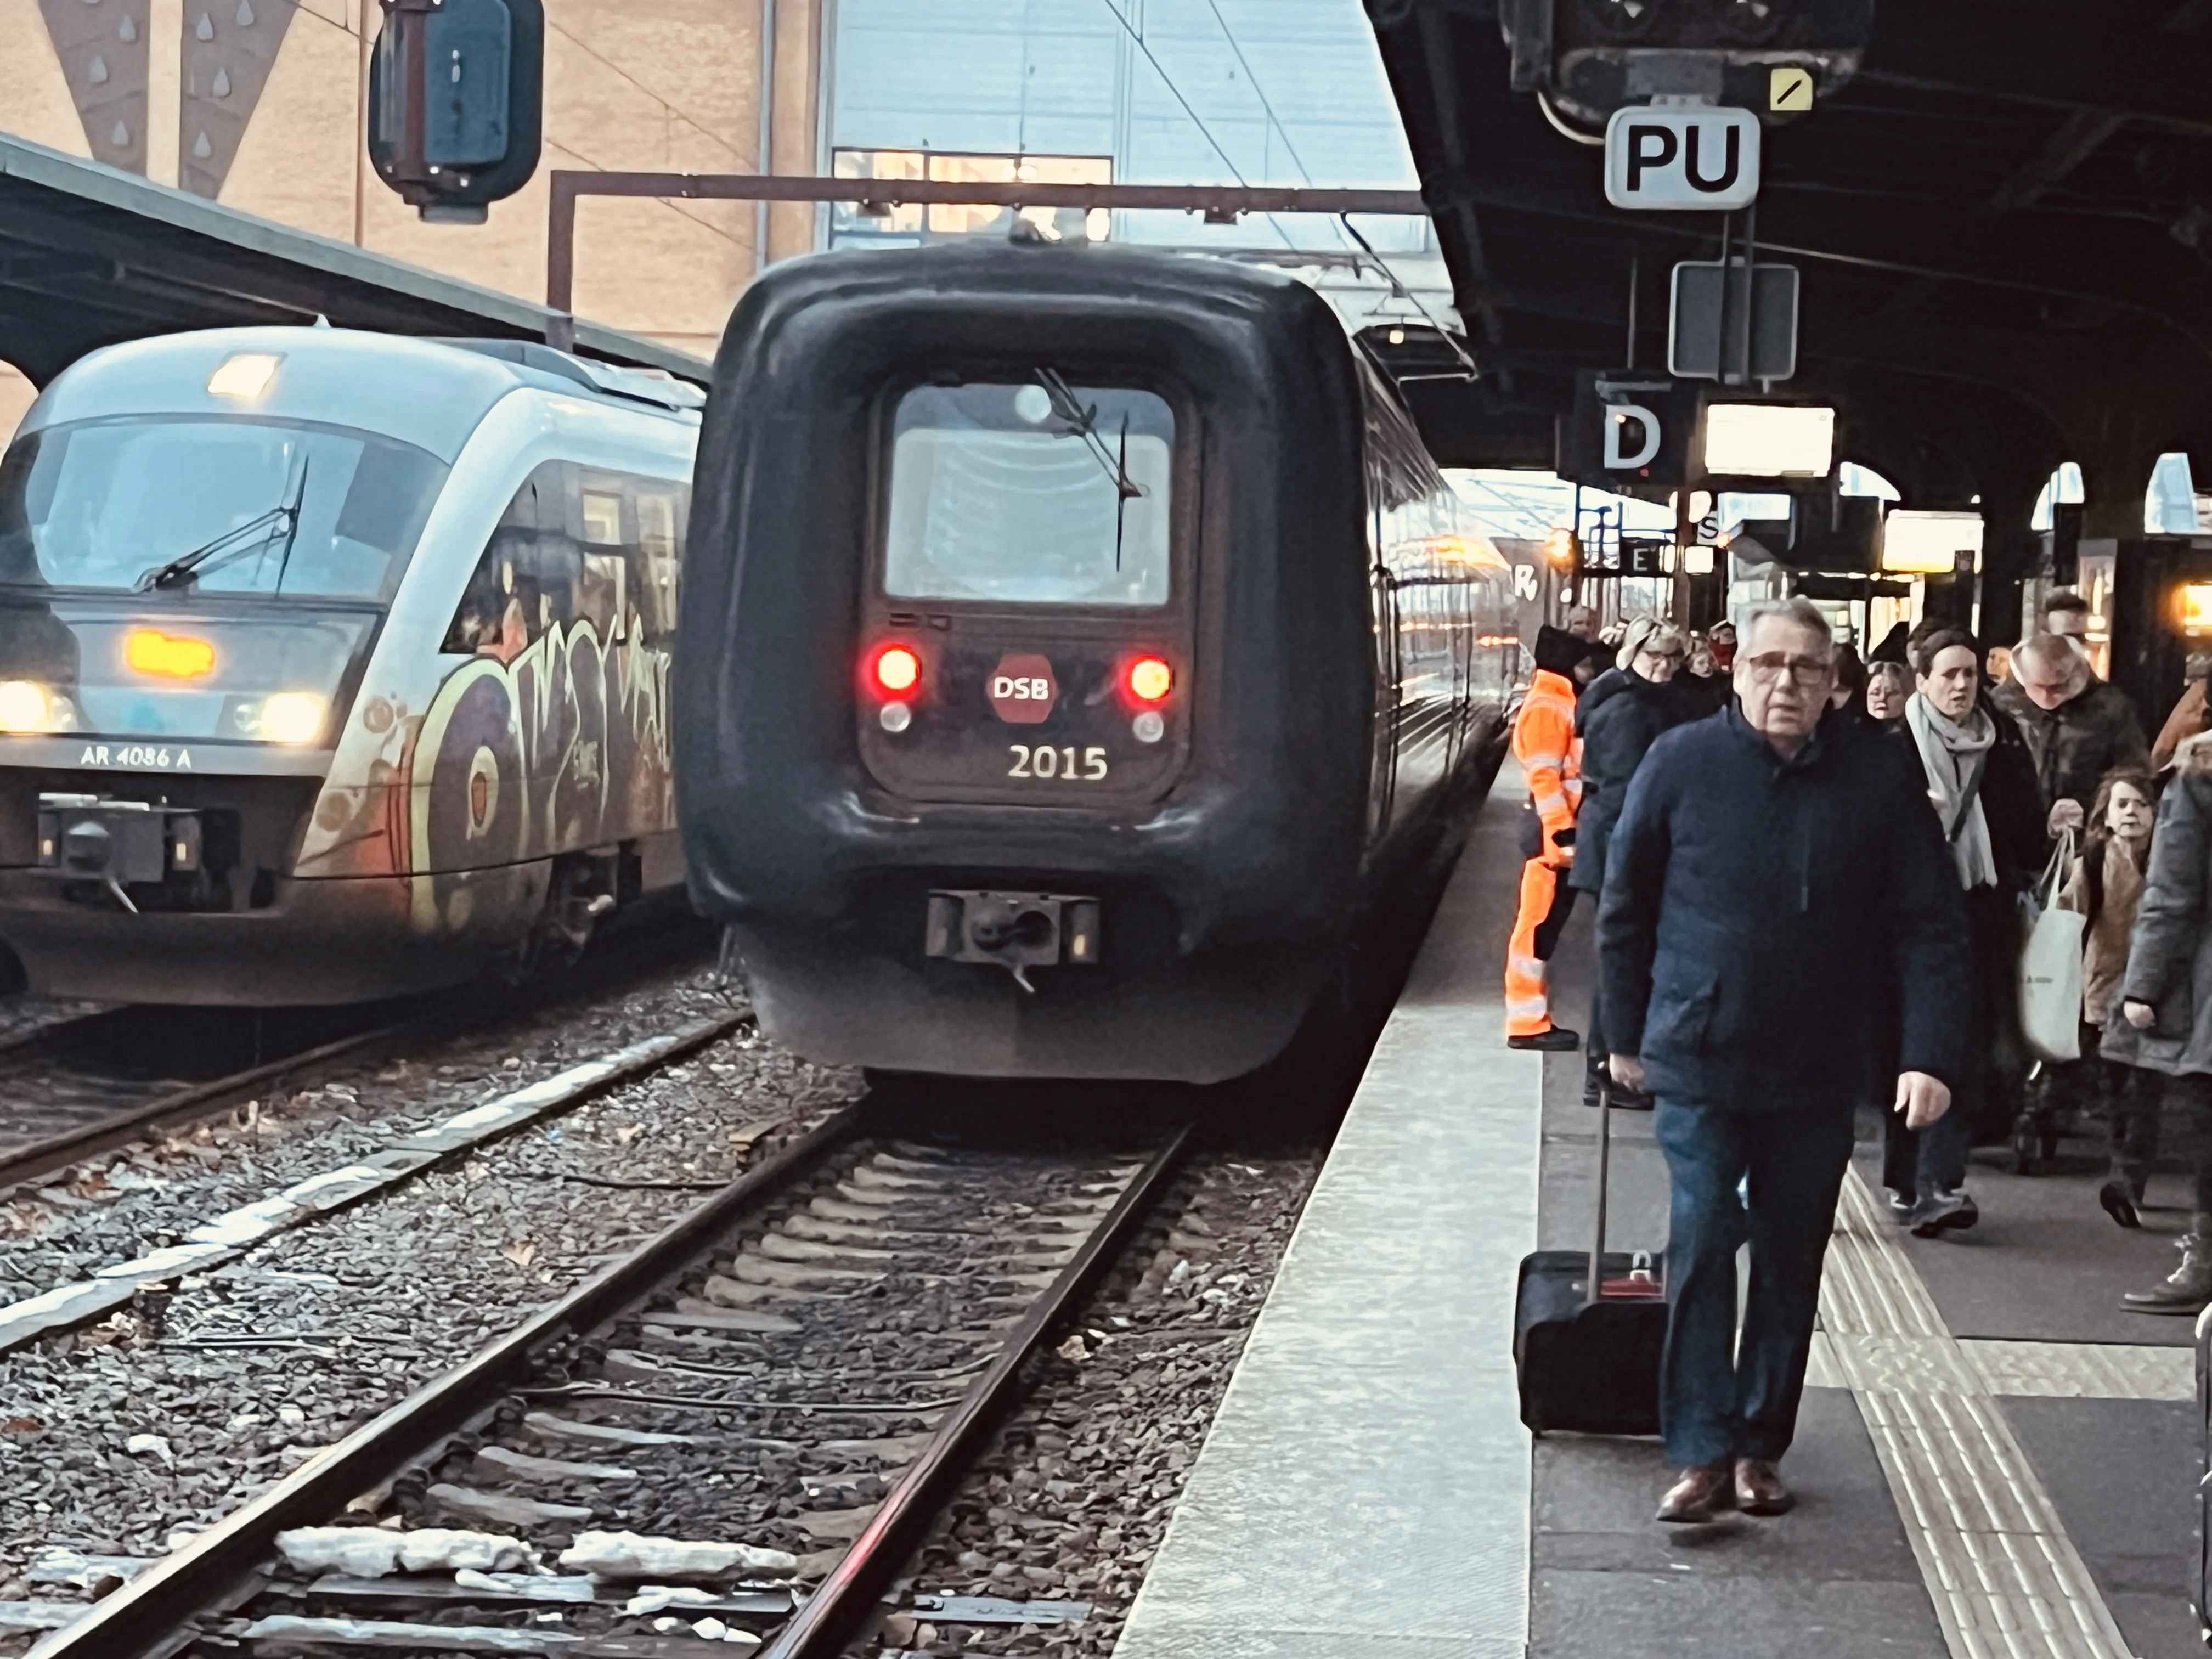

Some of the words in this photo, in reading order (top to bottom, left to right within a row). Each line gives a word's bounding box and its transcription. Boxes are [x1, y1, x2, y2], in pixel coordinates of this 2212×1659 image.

[1627, 125, 1740, 193] PU
[1604, 404, 1661, 469] D
[1699, 516, 1719, 539] S
[1633, 548, 1650, 571] E
[994, 676, 1048, 700] DSB
[81, 746, 109, 765] AR
[176, 749, 191, 769] A
[1008, 744, 1108, 780] 2015
